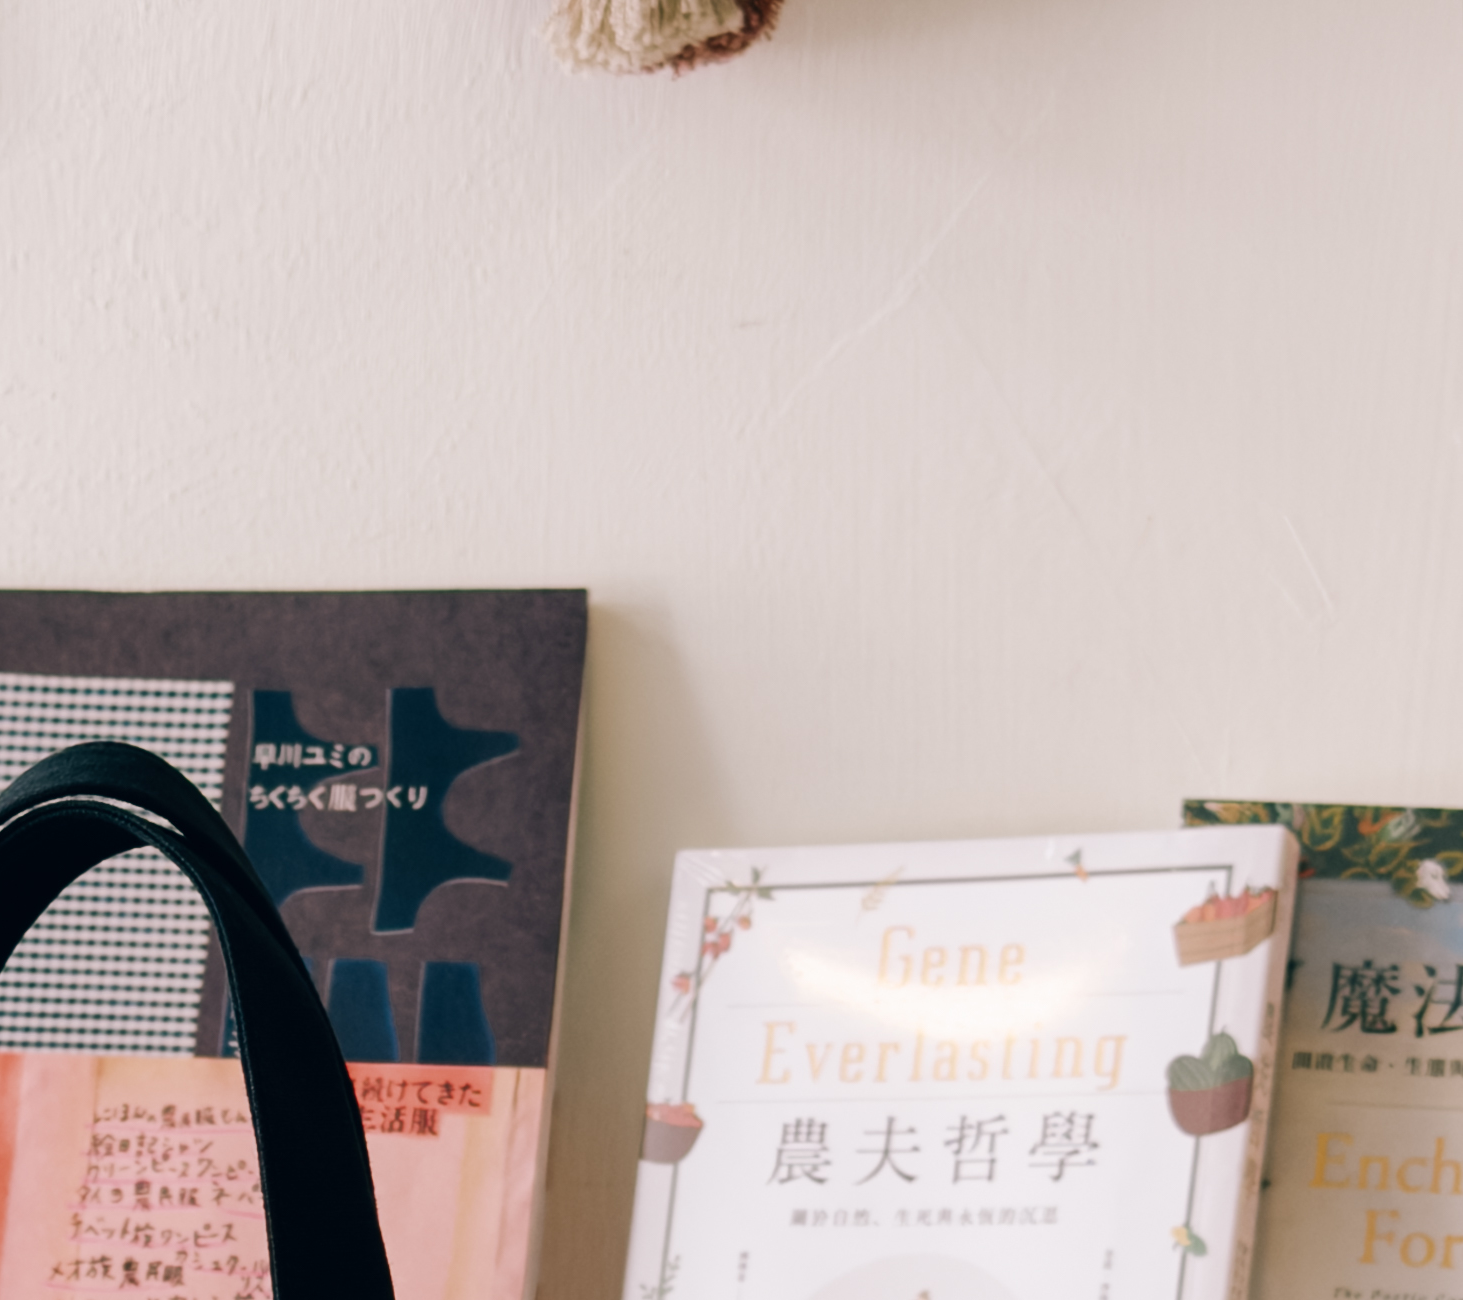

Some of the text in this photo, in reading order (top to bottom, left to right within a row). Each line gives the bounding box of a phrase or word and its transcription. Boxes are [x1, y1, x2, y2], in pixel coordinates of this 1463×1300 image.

[253, 743, 372, 770] 早川ユミの
[249, 783, 428, 812] ちくちく服つくり
[876, 925, 1027, 988] Gene
[1288, 955, 1463, 1039] 魔法
[754, 1020, 1130, 1092] Everlasting
[356, 1077, 483, 1107] 続けてきた
[766, 1110, 1101, 1187] 農夫哲學
